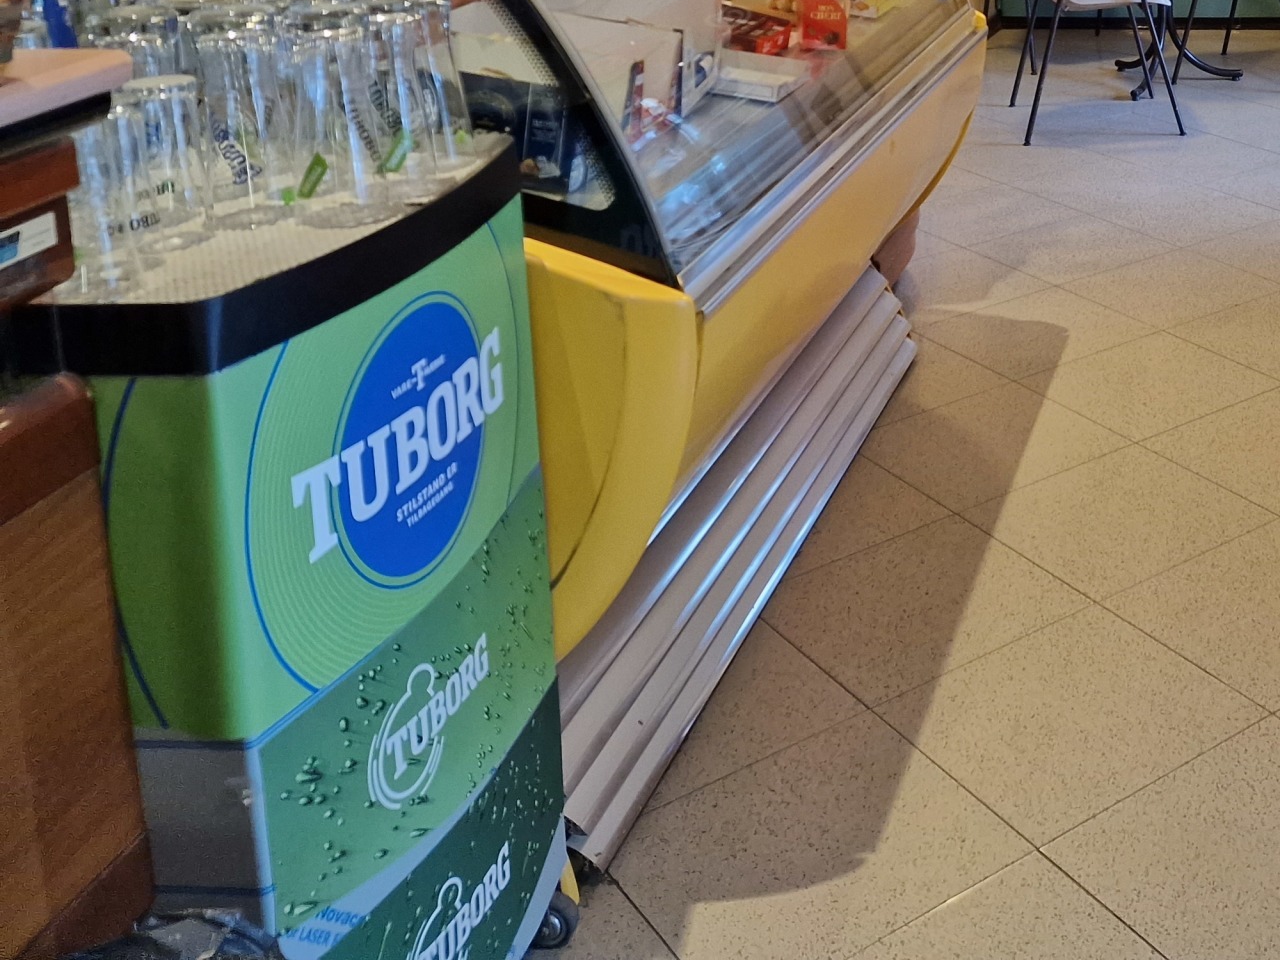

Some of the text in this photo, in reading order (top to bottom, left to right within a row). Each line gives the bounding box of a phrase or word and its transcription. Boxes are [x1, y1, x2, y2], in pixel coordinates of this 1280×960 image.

[290, 326, 504, 564] TUBORG
[396, 472, 446, 523] STILSTAND
[384, 632, 490, 780] TUBORG
[299, 928, 332, 948] LASER
[420, 840, 511, 960] TUBORG
